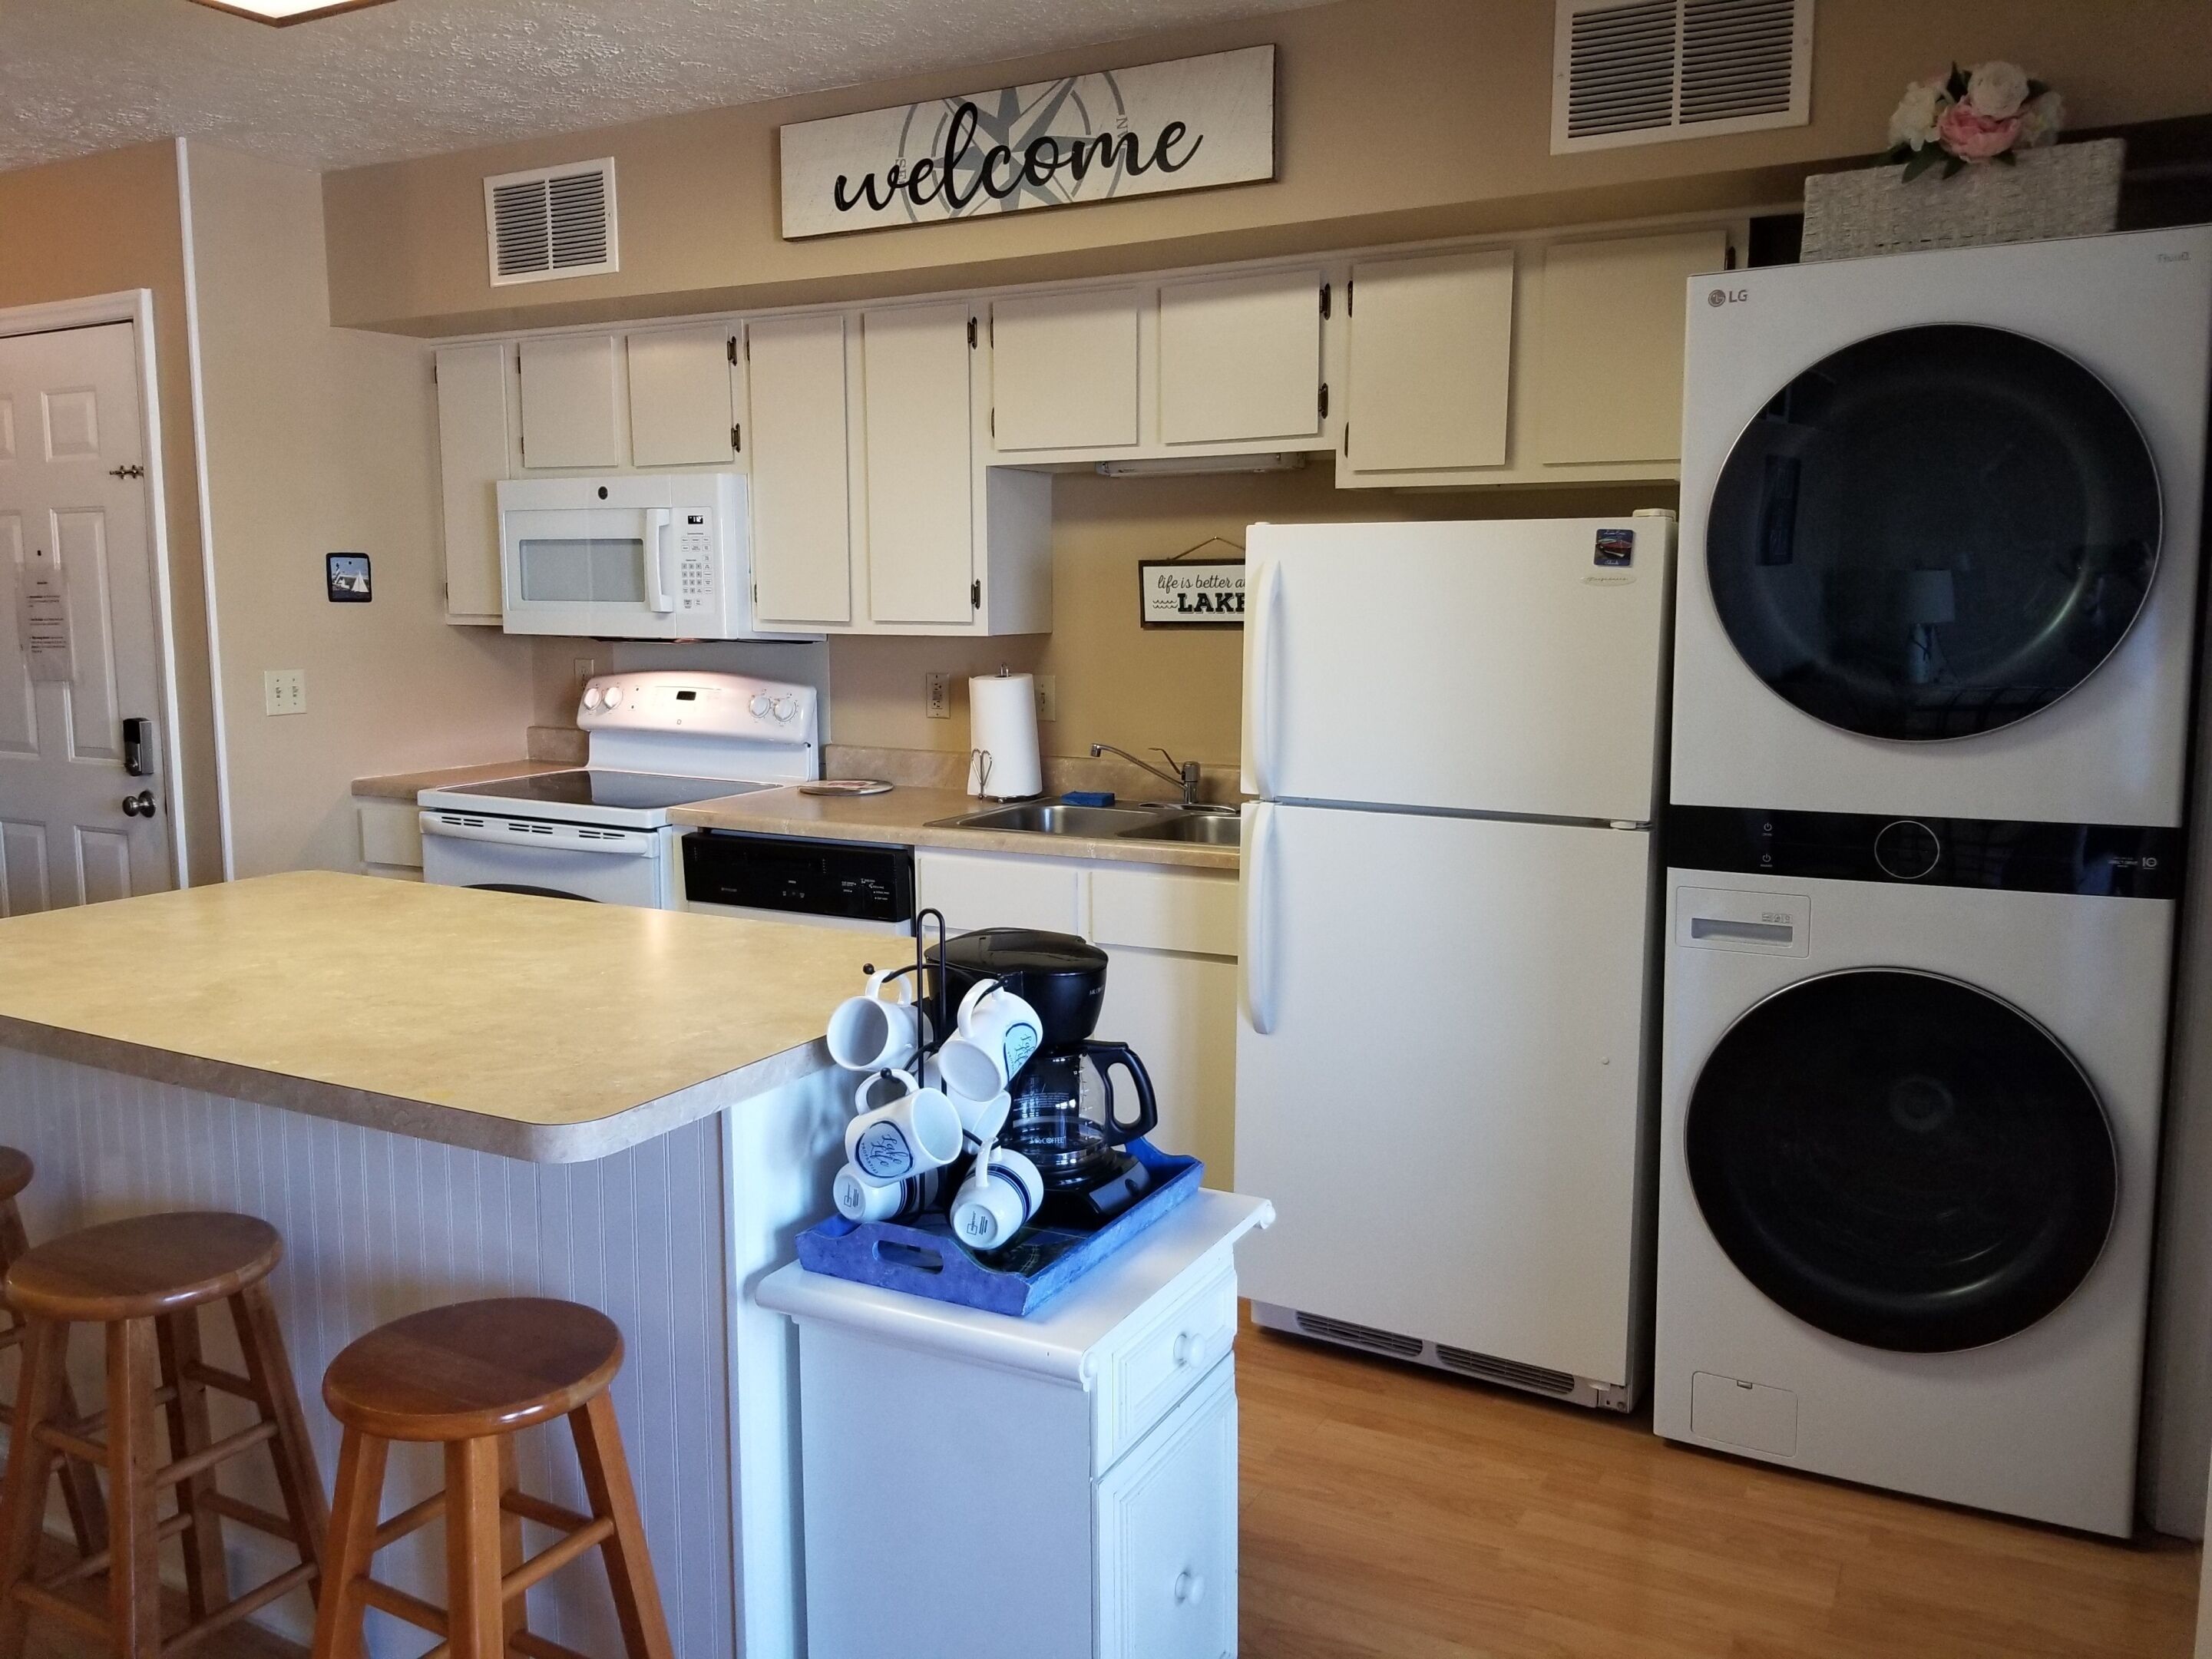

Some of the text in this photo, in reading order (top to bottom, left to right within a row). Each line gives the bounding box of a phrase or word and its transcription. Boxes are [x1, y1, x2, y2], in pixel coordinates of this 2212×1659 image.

[834, 101, 1204, 212] welcome
[1728, 289, 1748, 303] LG
[1158, 574, 1245, 594] life is better a
[1177, 593, 1245, 613] LAKE
[869, 1141, 896, 1167] Life
[880, 1134, 909, 1165] Lake
